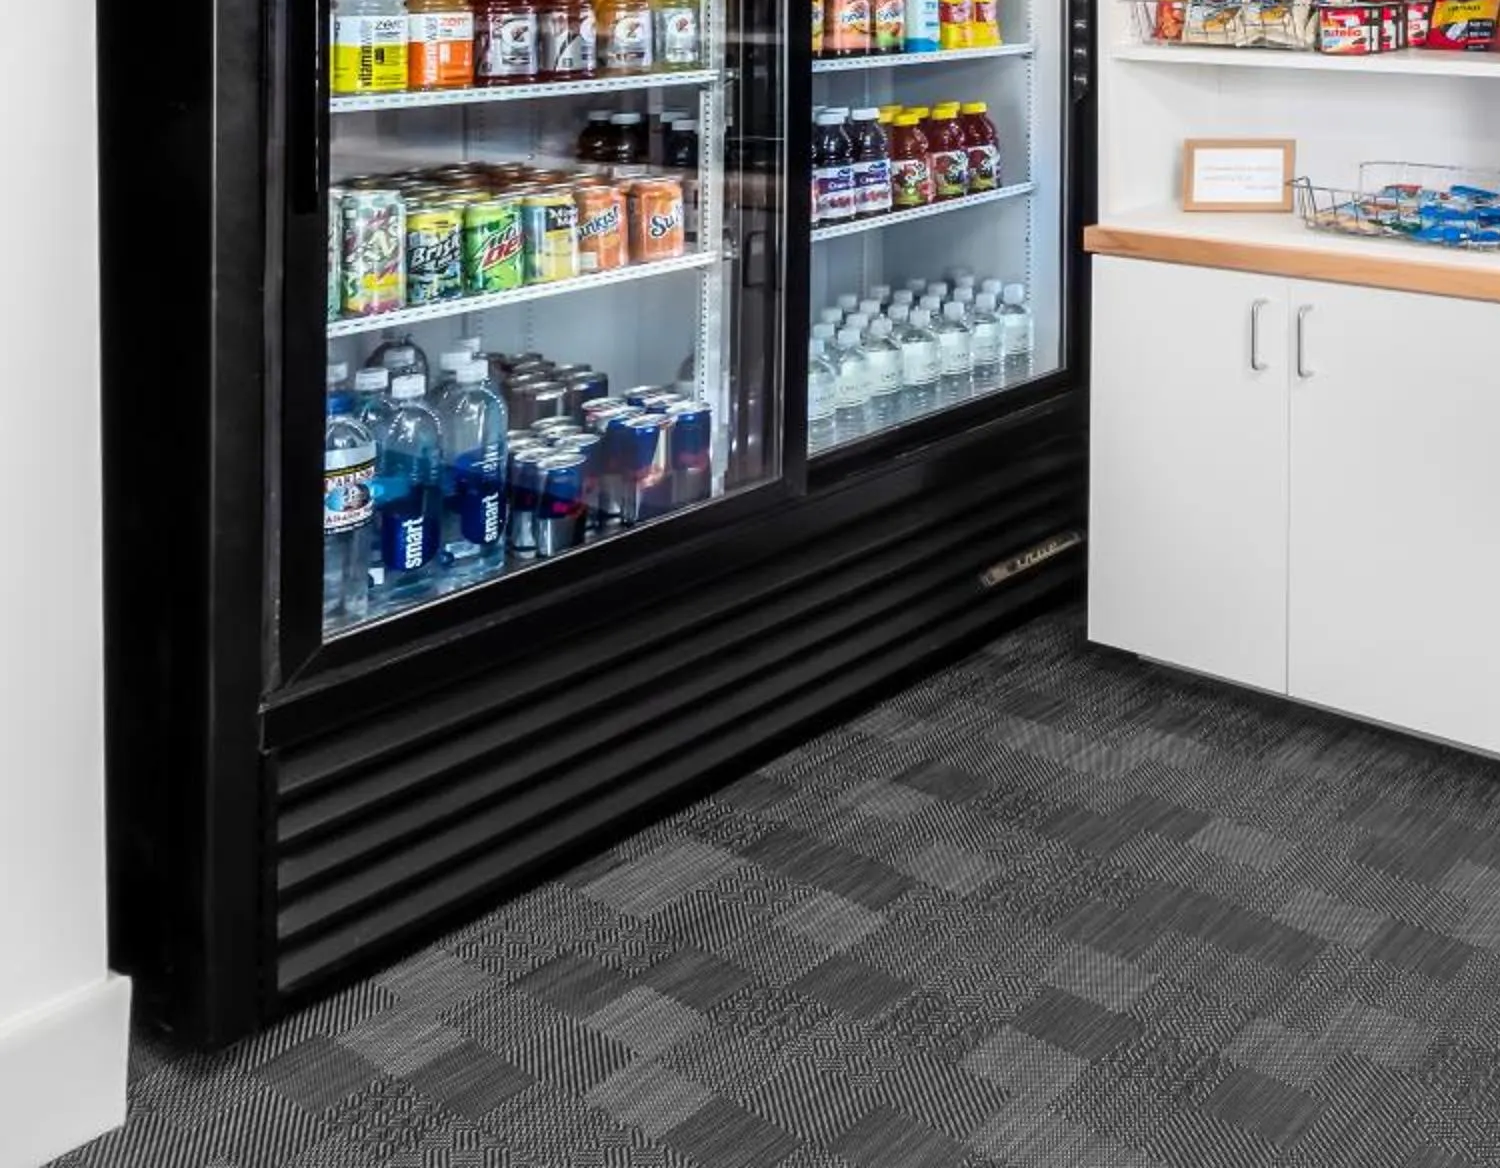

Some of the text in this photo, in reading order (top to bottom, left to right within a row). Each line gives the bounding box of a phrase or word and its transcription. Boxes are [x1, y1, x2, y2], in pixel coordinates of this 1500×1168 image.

[577, 203, 621, 241] unkist
[402, 515, 425, 570] smart
[483, 491, 500, 544] smart
